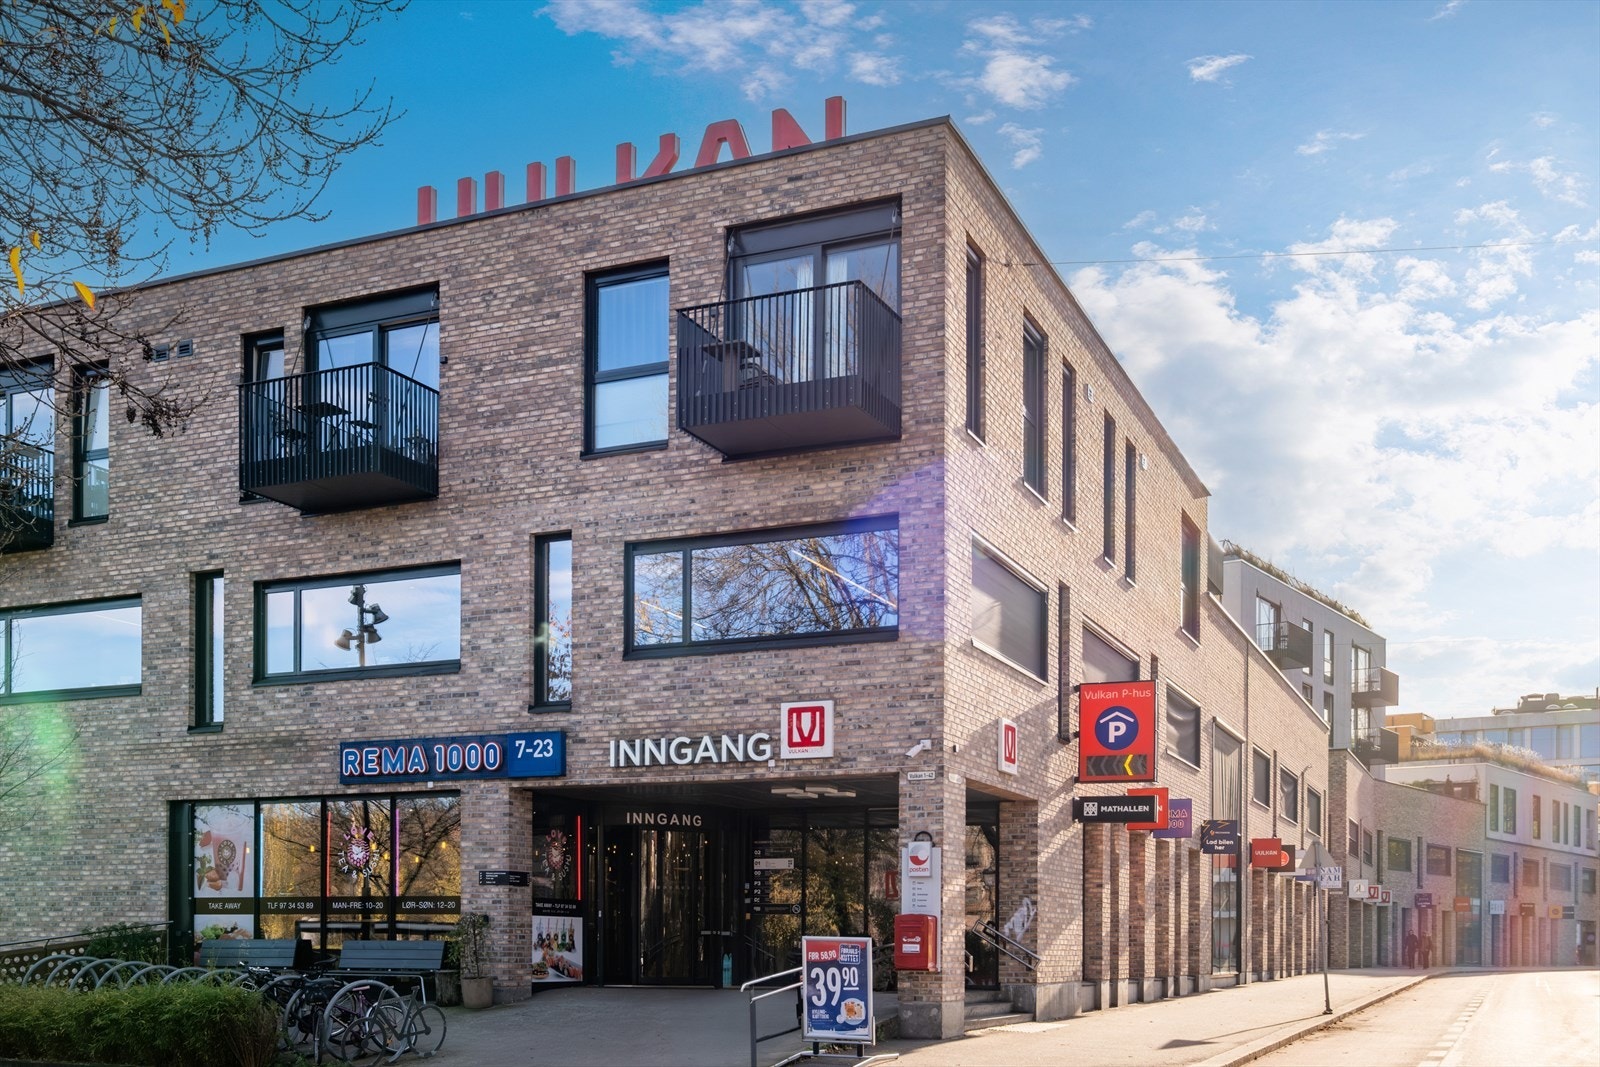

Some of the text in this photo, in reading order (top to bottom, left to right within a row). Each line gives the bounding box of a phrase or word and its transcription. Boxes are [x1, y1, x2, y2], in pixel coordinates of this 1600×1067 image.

[1084, 689, 1152, 700] Vulkan P-hus
[1108, 721, 1127, 743] P
[515, 739, 554, 758] 7-23
[609, 732, 772, 768] INNGANG
[342, 742, 503, 775] REMA 1000
[626, 812, 702, 827] INNGANG
[1168, 809, 1188, 818] MA
[1168, 820, 1185, 829] 00
[343, 826, 375, 841] LOVE
[337, 850, 349, 874] TEA
[362, 849, 380, 878] SUSHI
[437, 901, 456, 909] 12-20
